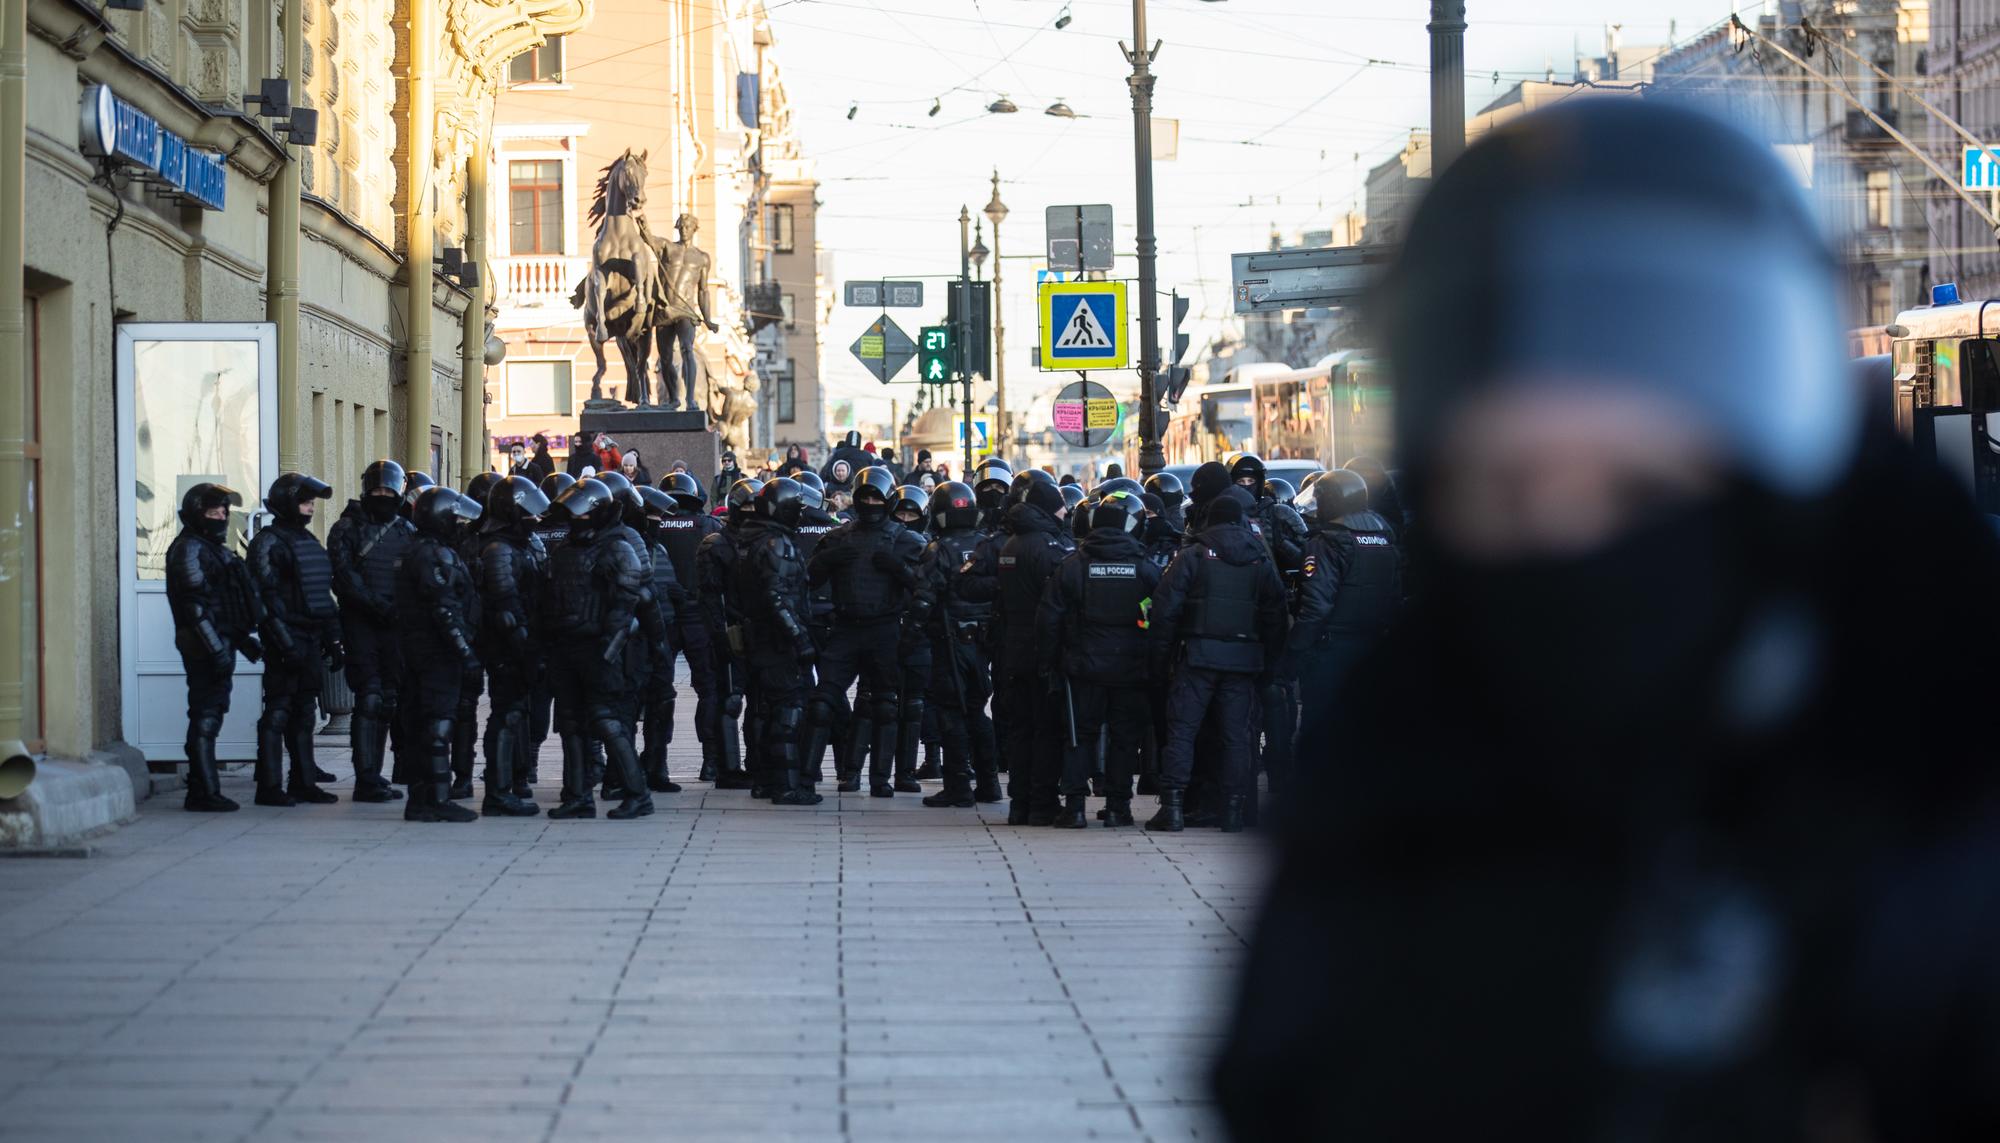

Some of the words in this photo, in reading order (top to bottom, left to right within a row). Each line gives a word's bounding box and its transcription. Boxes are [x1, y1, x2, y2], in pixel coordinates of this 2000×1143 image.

[926, 331, 946, 350] 27
[658, 520, 694, 530] ОЛИЦИЯ
[796, 526, 832, 535] ОЛИЦИЯ
[1090, 566, 1106, 576] МВД
[1107, 566, 1135, 576] РОССИИ
